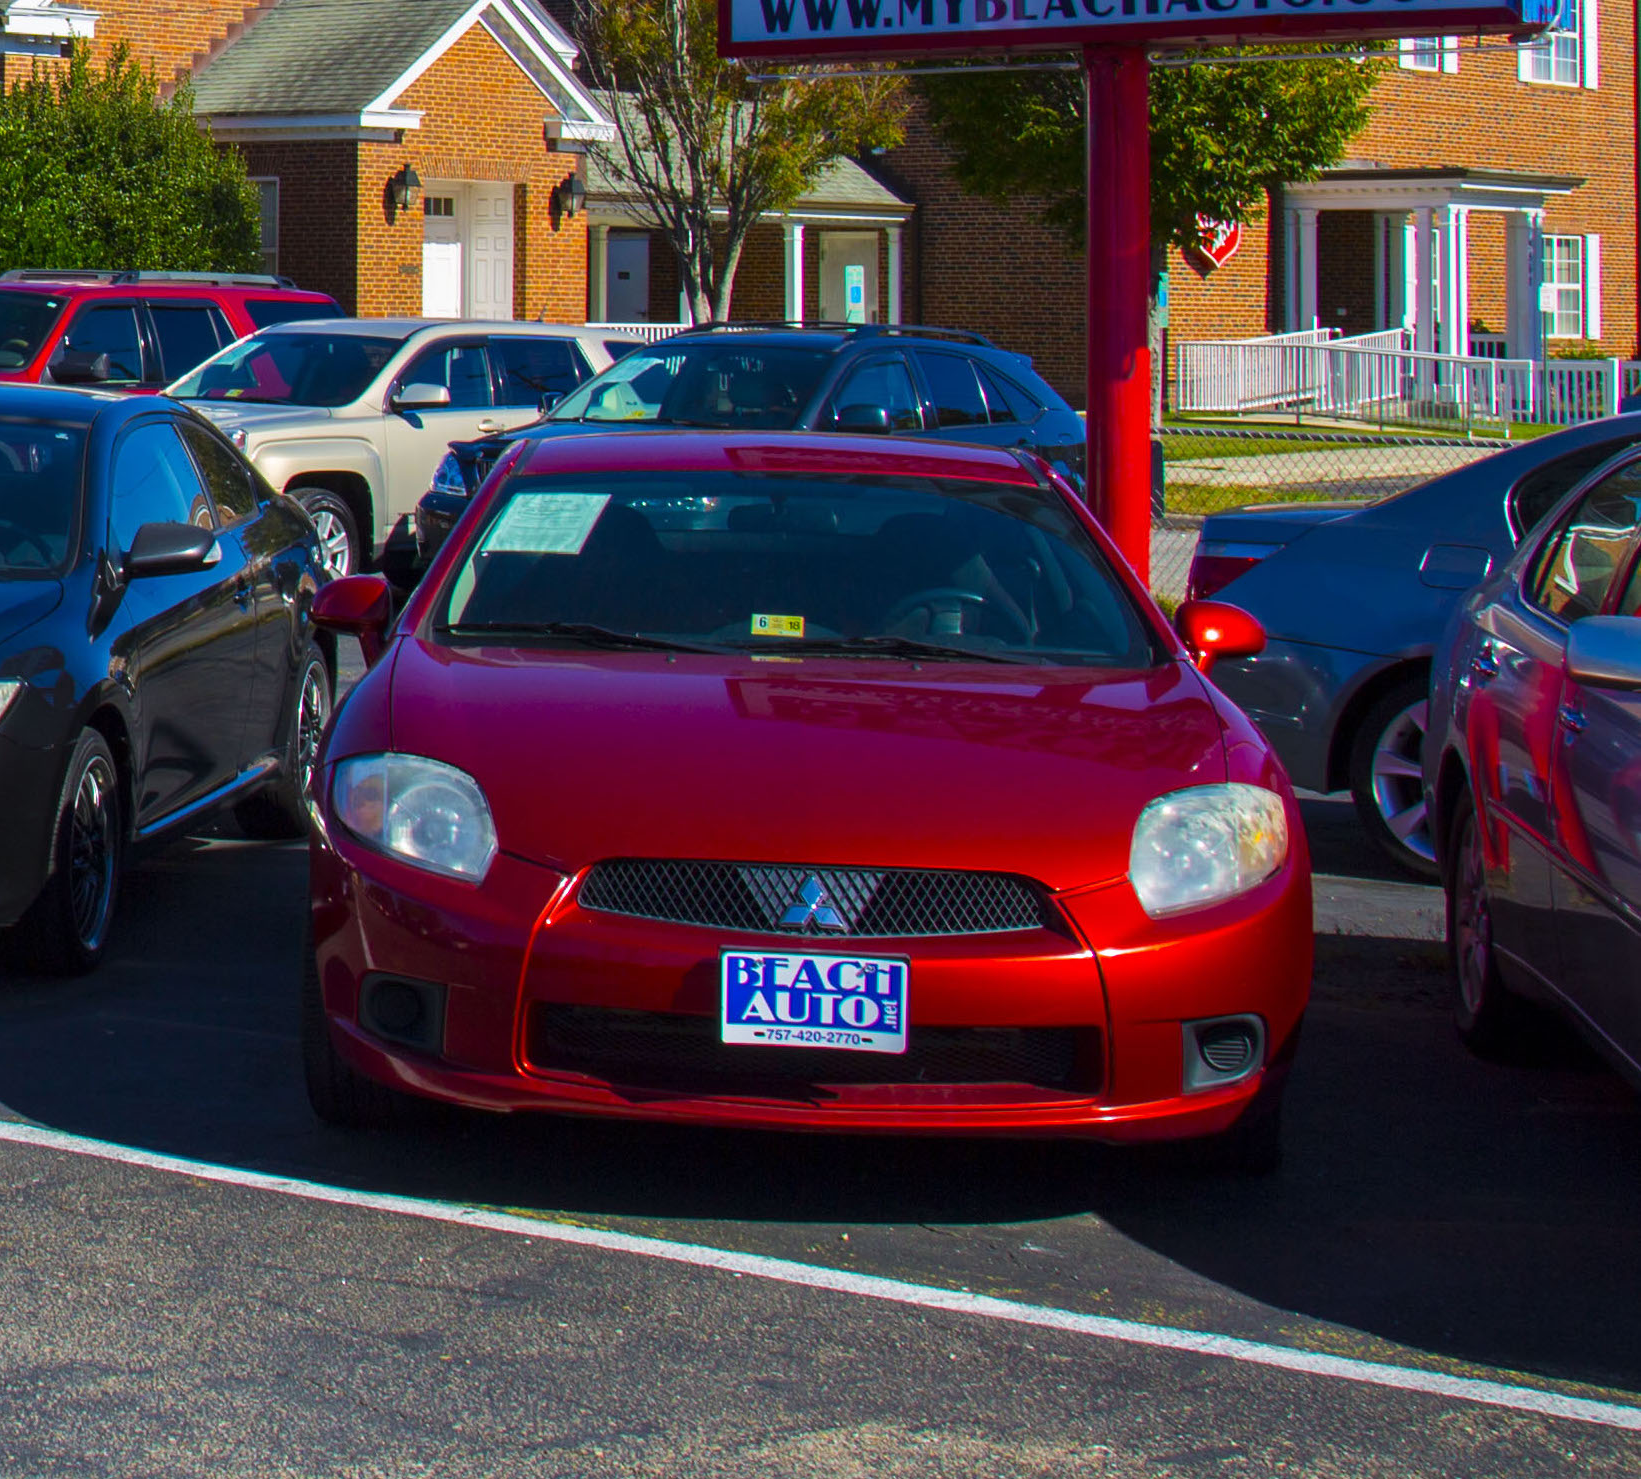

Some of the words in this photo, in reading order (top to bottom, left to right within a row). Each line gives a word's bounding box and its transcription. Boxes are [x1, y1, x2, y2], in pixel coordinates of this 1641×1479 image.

[727, 956, 902, 995] BEACH
[741, 990, 881, 1027] AUTO
[884, 999, 898, 1030] .net
[766, 1029, 861, 1045] 757-420-2770
